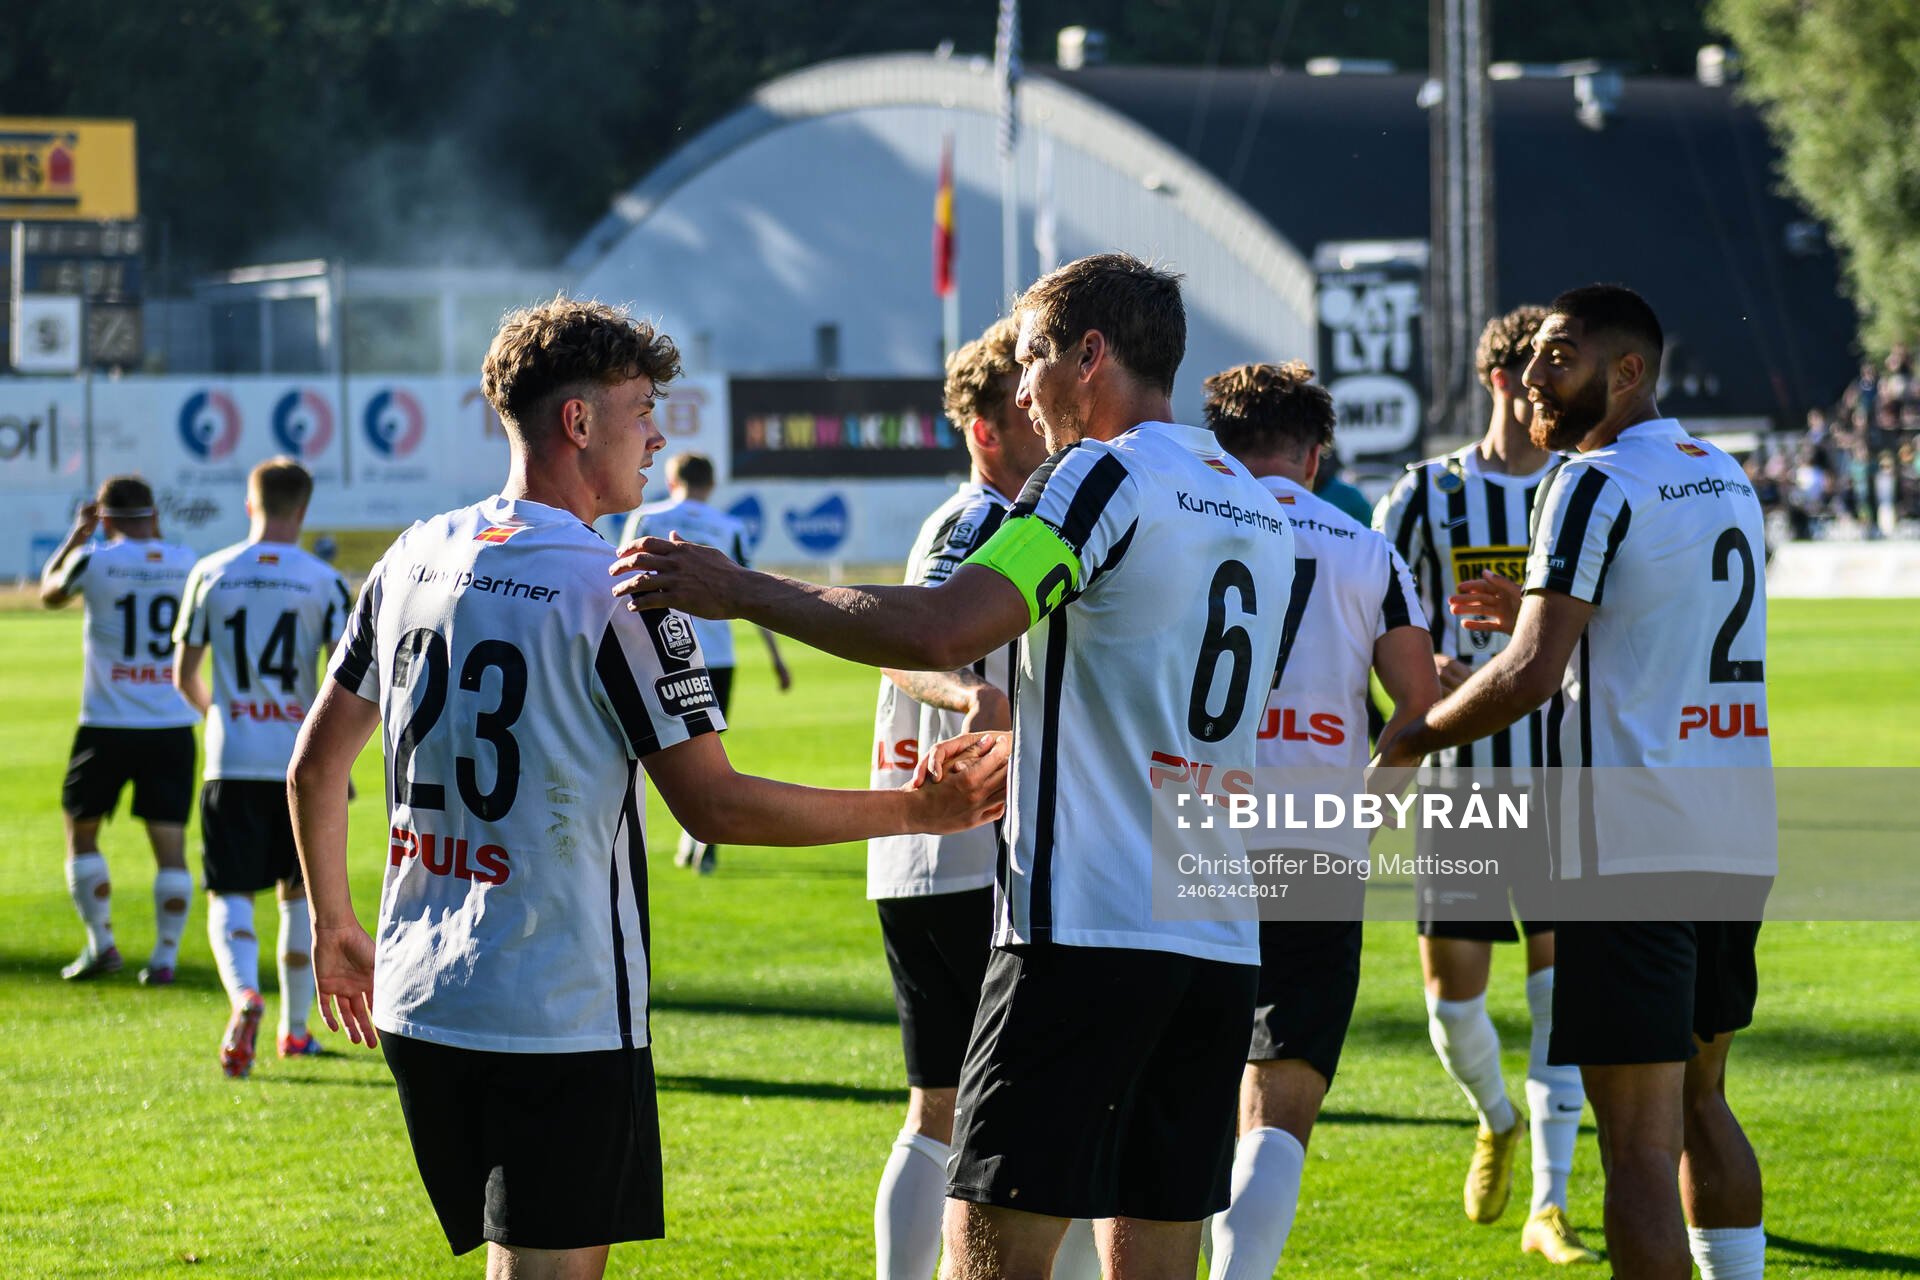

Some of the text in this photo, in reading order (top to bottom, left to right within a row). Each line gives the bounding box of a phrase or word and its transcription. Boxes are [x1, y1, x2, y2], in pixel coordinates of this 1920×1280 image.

[1176, 491, 1283, 536] Kundpartner
[114, 591, 179, 660] 19
[1709, 527, 1764, 683] 2
[223, 607, 298, 693] 14
[1187, 559, 1258, 743] 6
[230, 700, 305, 723] PULS
[392, 627, 529, 823] 23
[391, 826, 511, 887] PULS
